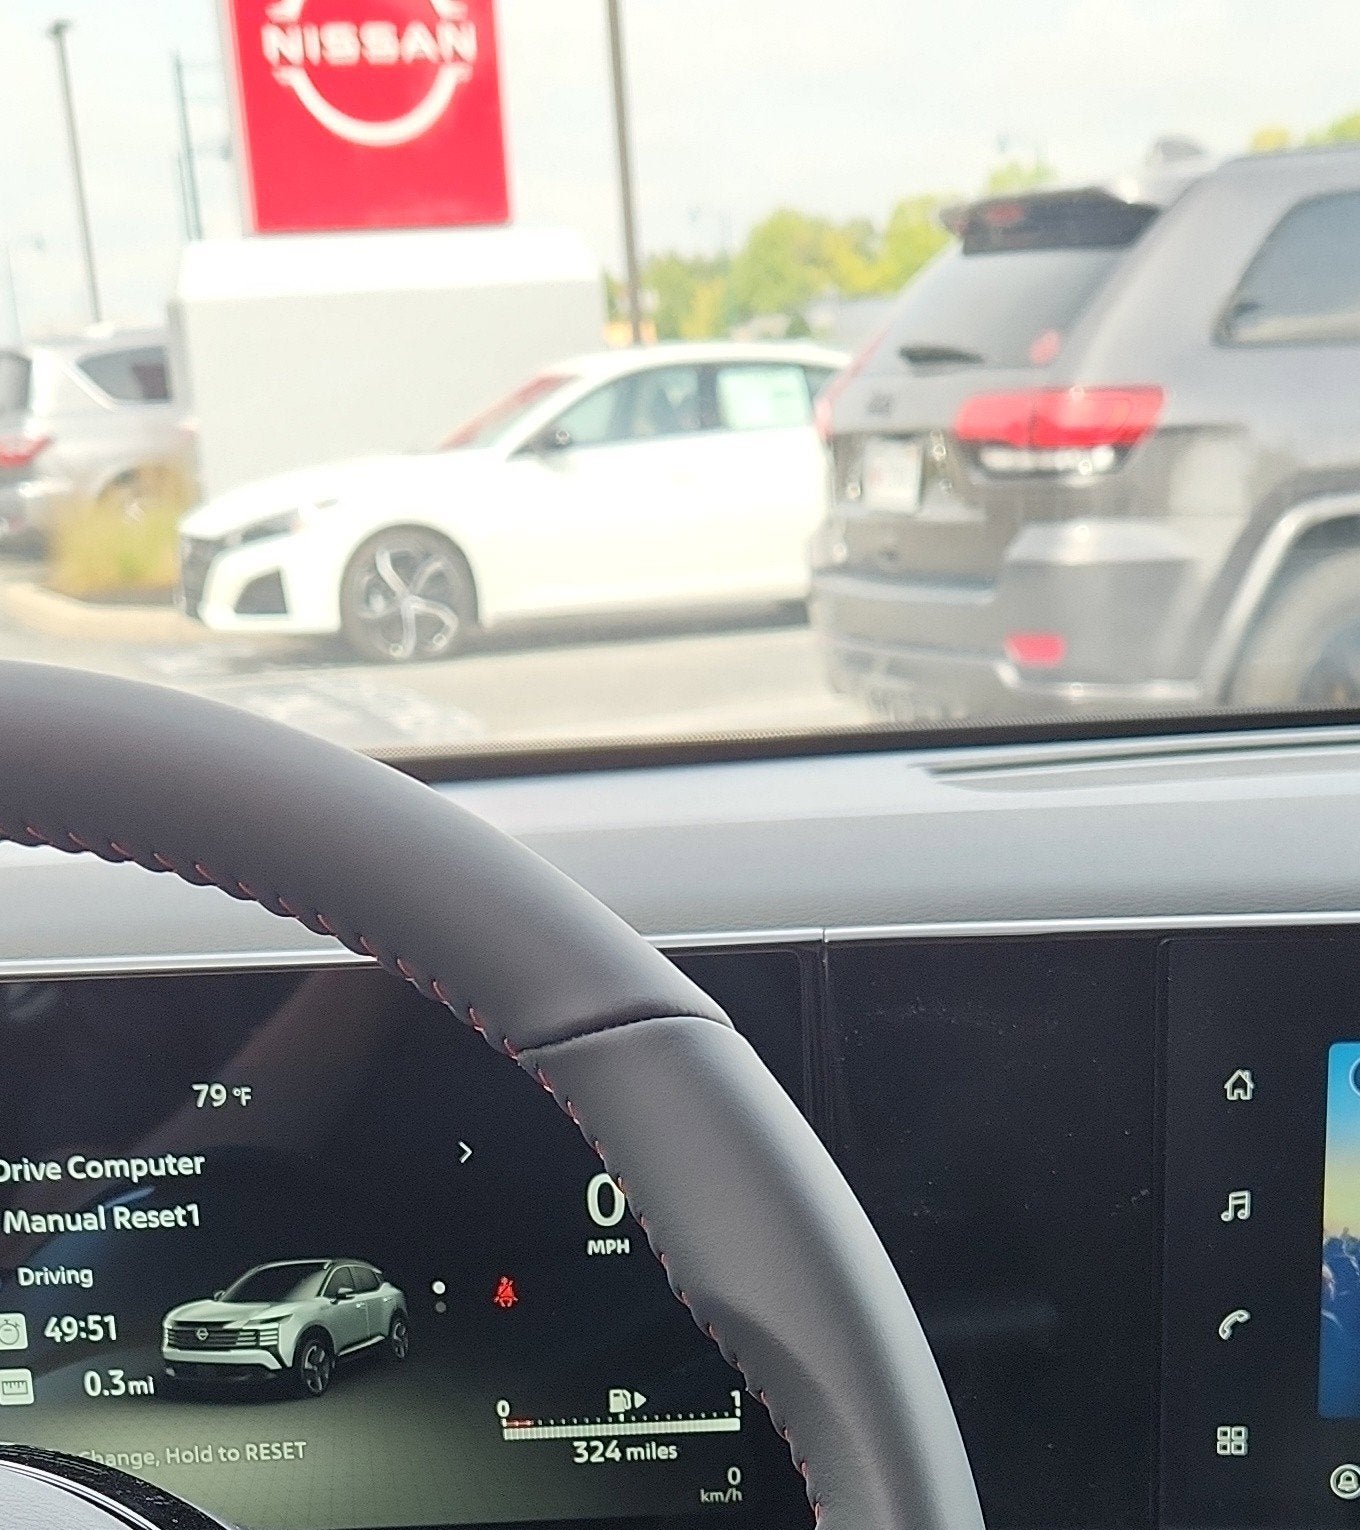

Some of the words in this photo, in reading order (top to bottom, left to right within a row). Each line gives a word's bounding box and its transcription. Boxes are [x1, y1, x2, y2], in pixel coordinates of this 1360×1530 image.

[260, 21, 478, 66] NISSAN
[192, 1083, 227, 1107] 79
[67, 1154, 205, 1183] Computer
[587, 1173, 625, 1227] 0
[3, 1205, 106, 1234] Manual
[112, 1203, 200, 1230] Reset1
[587, 1238, 630, 1255] MPH
[17, 1265, 94, 1288] Driving
[44, 1314, 117, 1343] 49:51
[496, 1400, 510, 1418] 0
[730, 1390, 741, 1408] 1
[166, 1444, 213, 1464] Hold
[217, 1445, 241, 1461] to
[245, 1441, 307, 1461] RESET
[573, 1439, 622, 1463] 324
[626, 1441, 678, 1461] miles
[727, 1467, 742, 1486] 0
[700, 1487, 743, 1504] km/h
